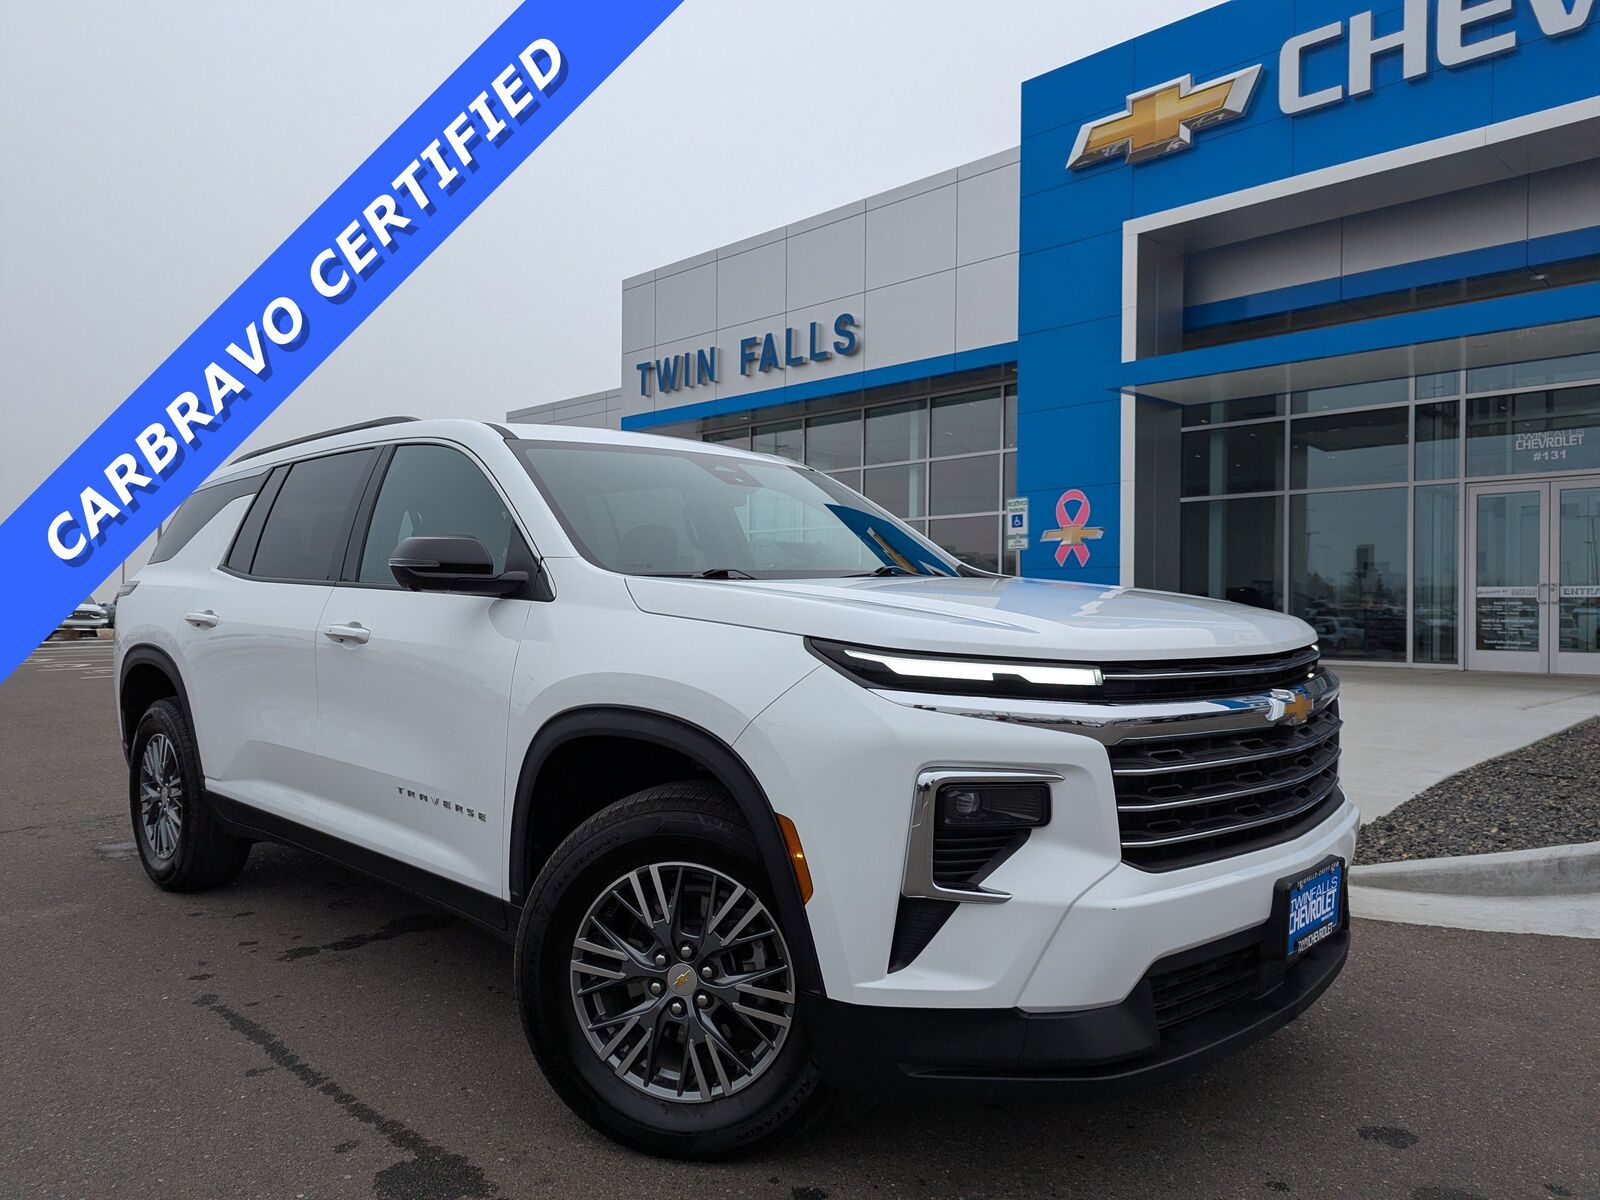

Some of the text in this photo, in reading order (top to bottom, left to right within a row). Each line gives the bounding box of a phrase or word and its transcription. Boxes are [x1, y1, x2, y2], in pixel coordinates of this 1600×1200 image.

[636, 313, 861, 397] TWIN FALLS
[1515, 434, 1585, 451] CHEVROLET
[1533, 449, 1567, 462] #131
[396, 786, 487, 823] TRAVERSE
[1288, 887, 1337, 935] CHEVROLET
[1290, 876, 1338, 913] TWINFALLS
